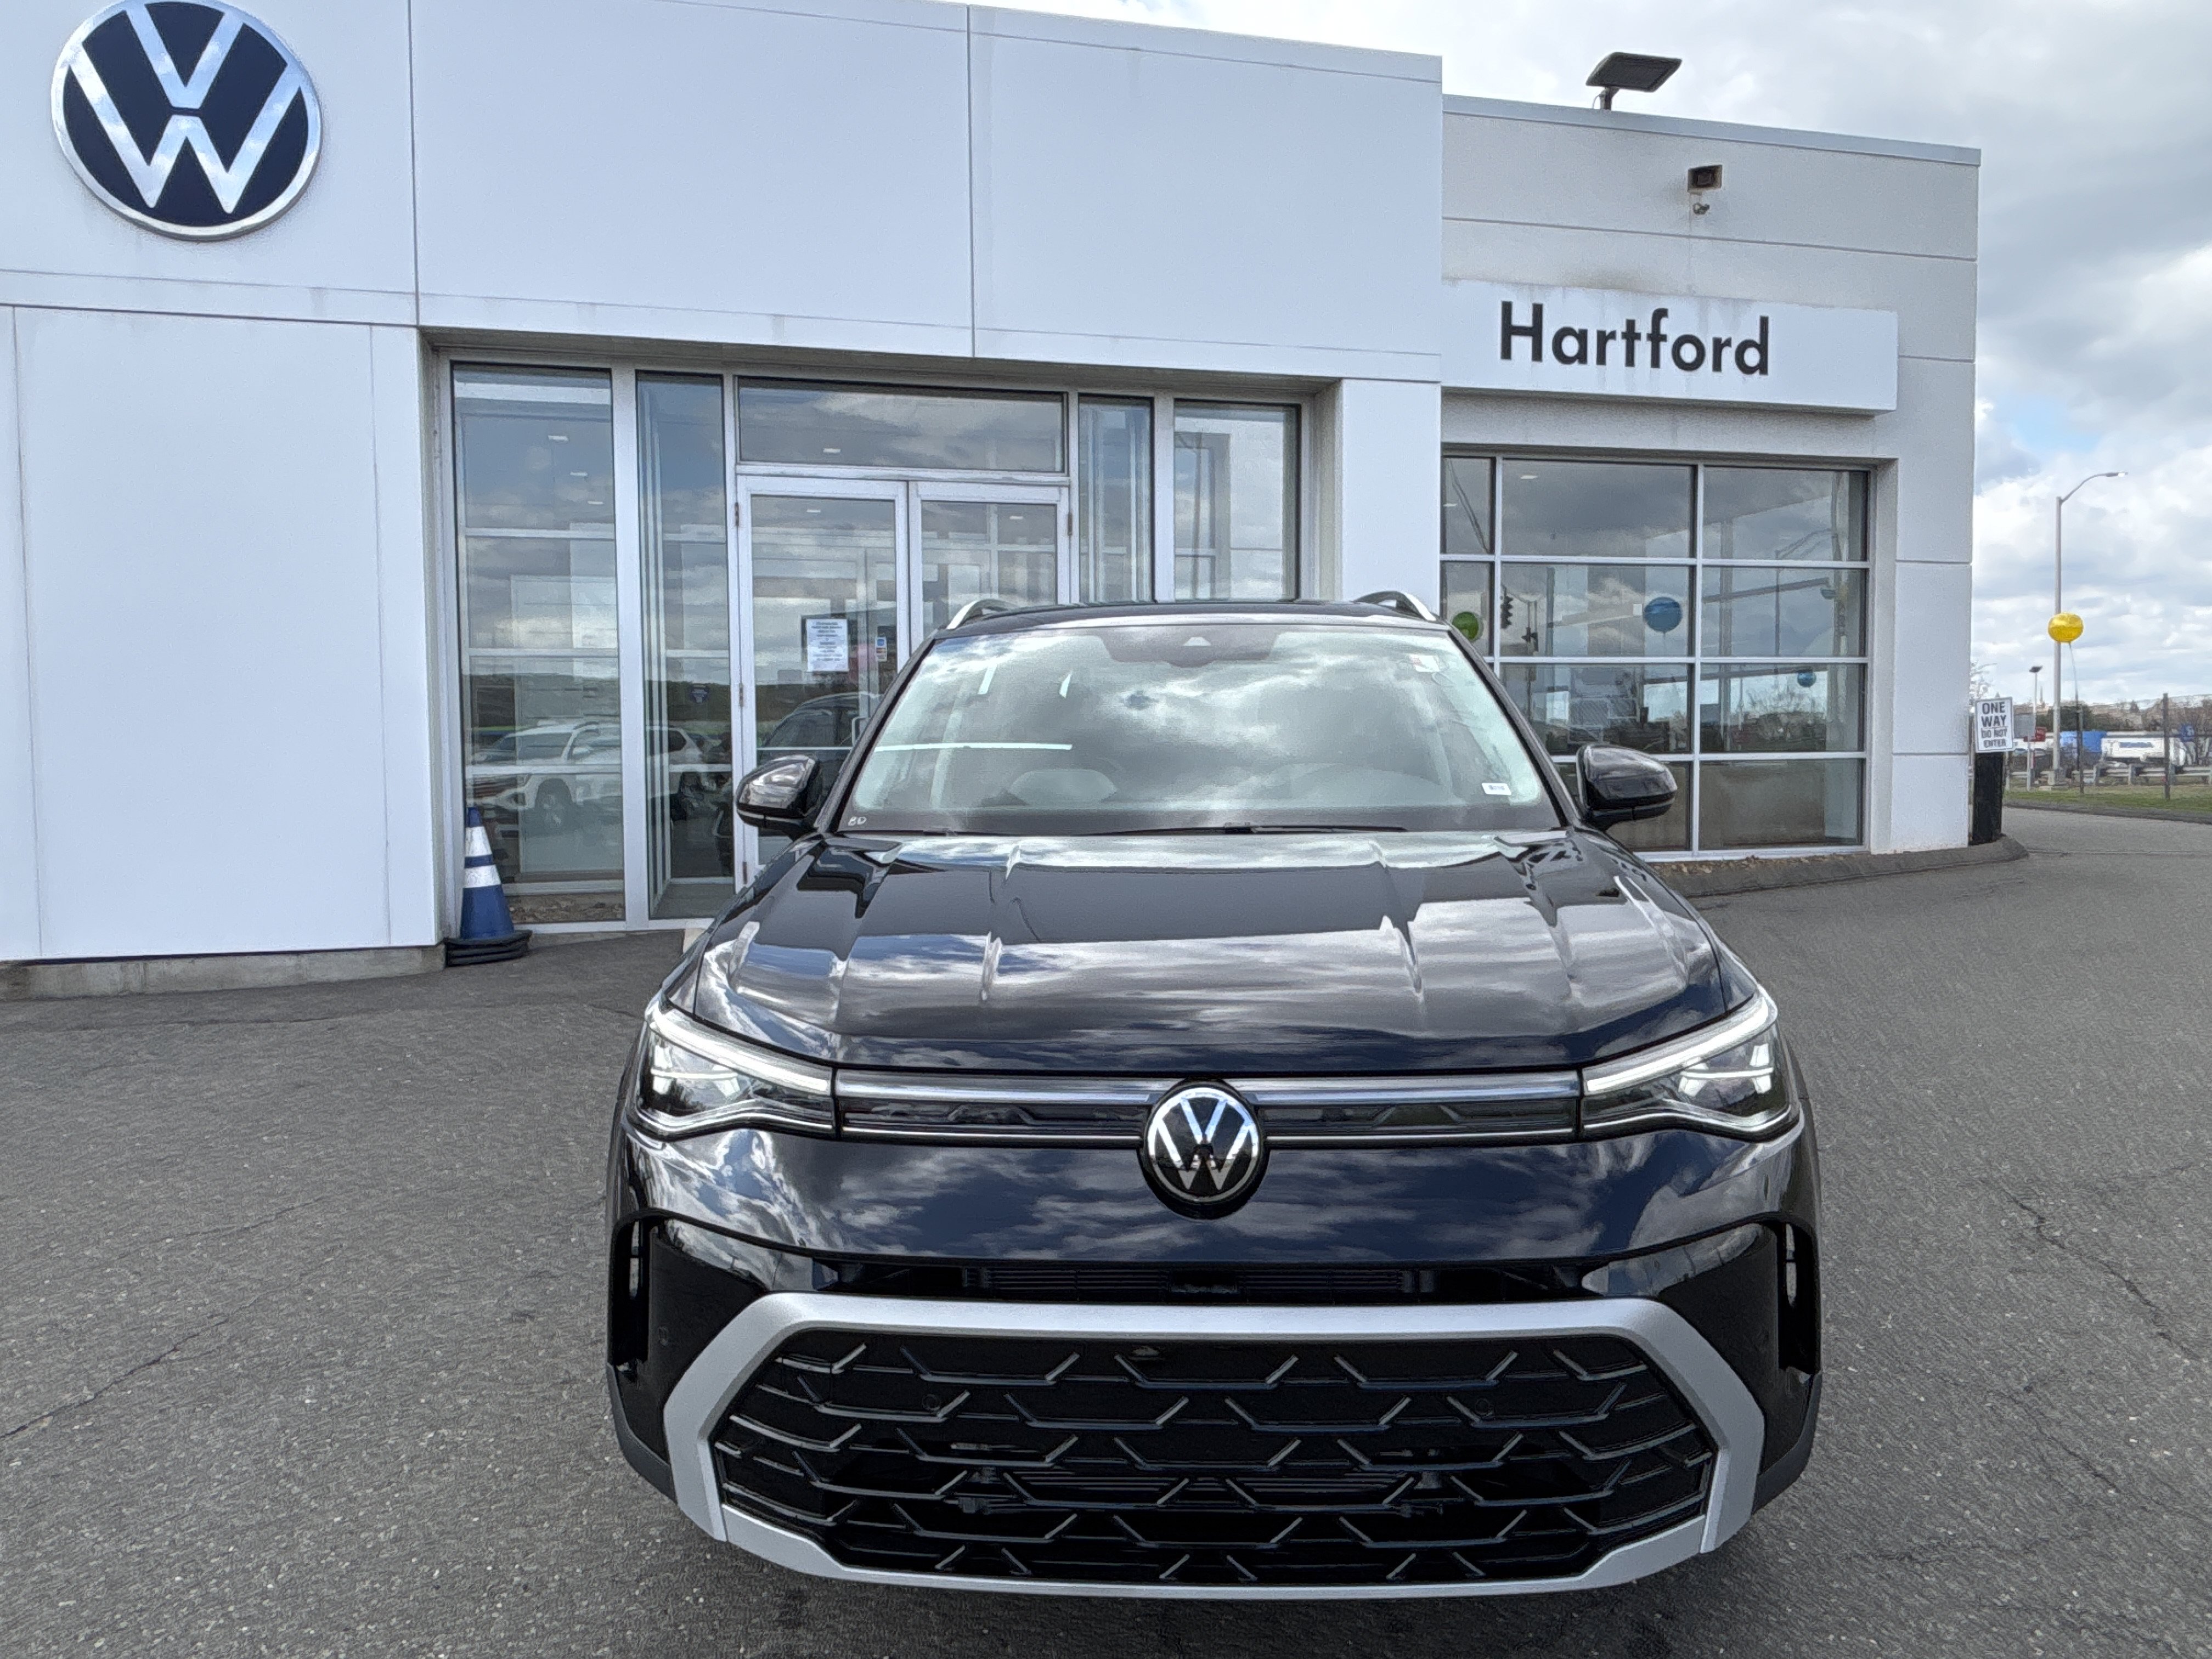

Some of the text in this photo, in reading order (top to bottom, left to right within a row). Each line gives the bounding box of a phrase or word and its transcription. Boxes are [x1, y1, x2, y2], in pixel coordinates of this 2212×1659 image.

[1500, 301, 1769, 375] Hartford
[1982, 702, 2006, 714] ONE
[1981, 715, 2007, 727] WAY
